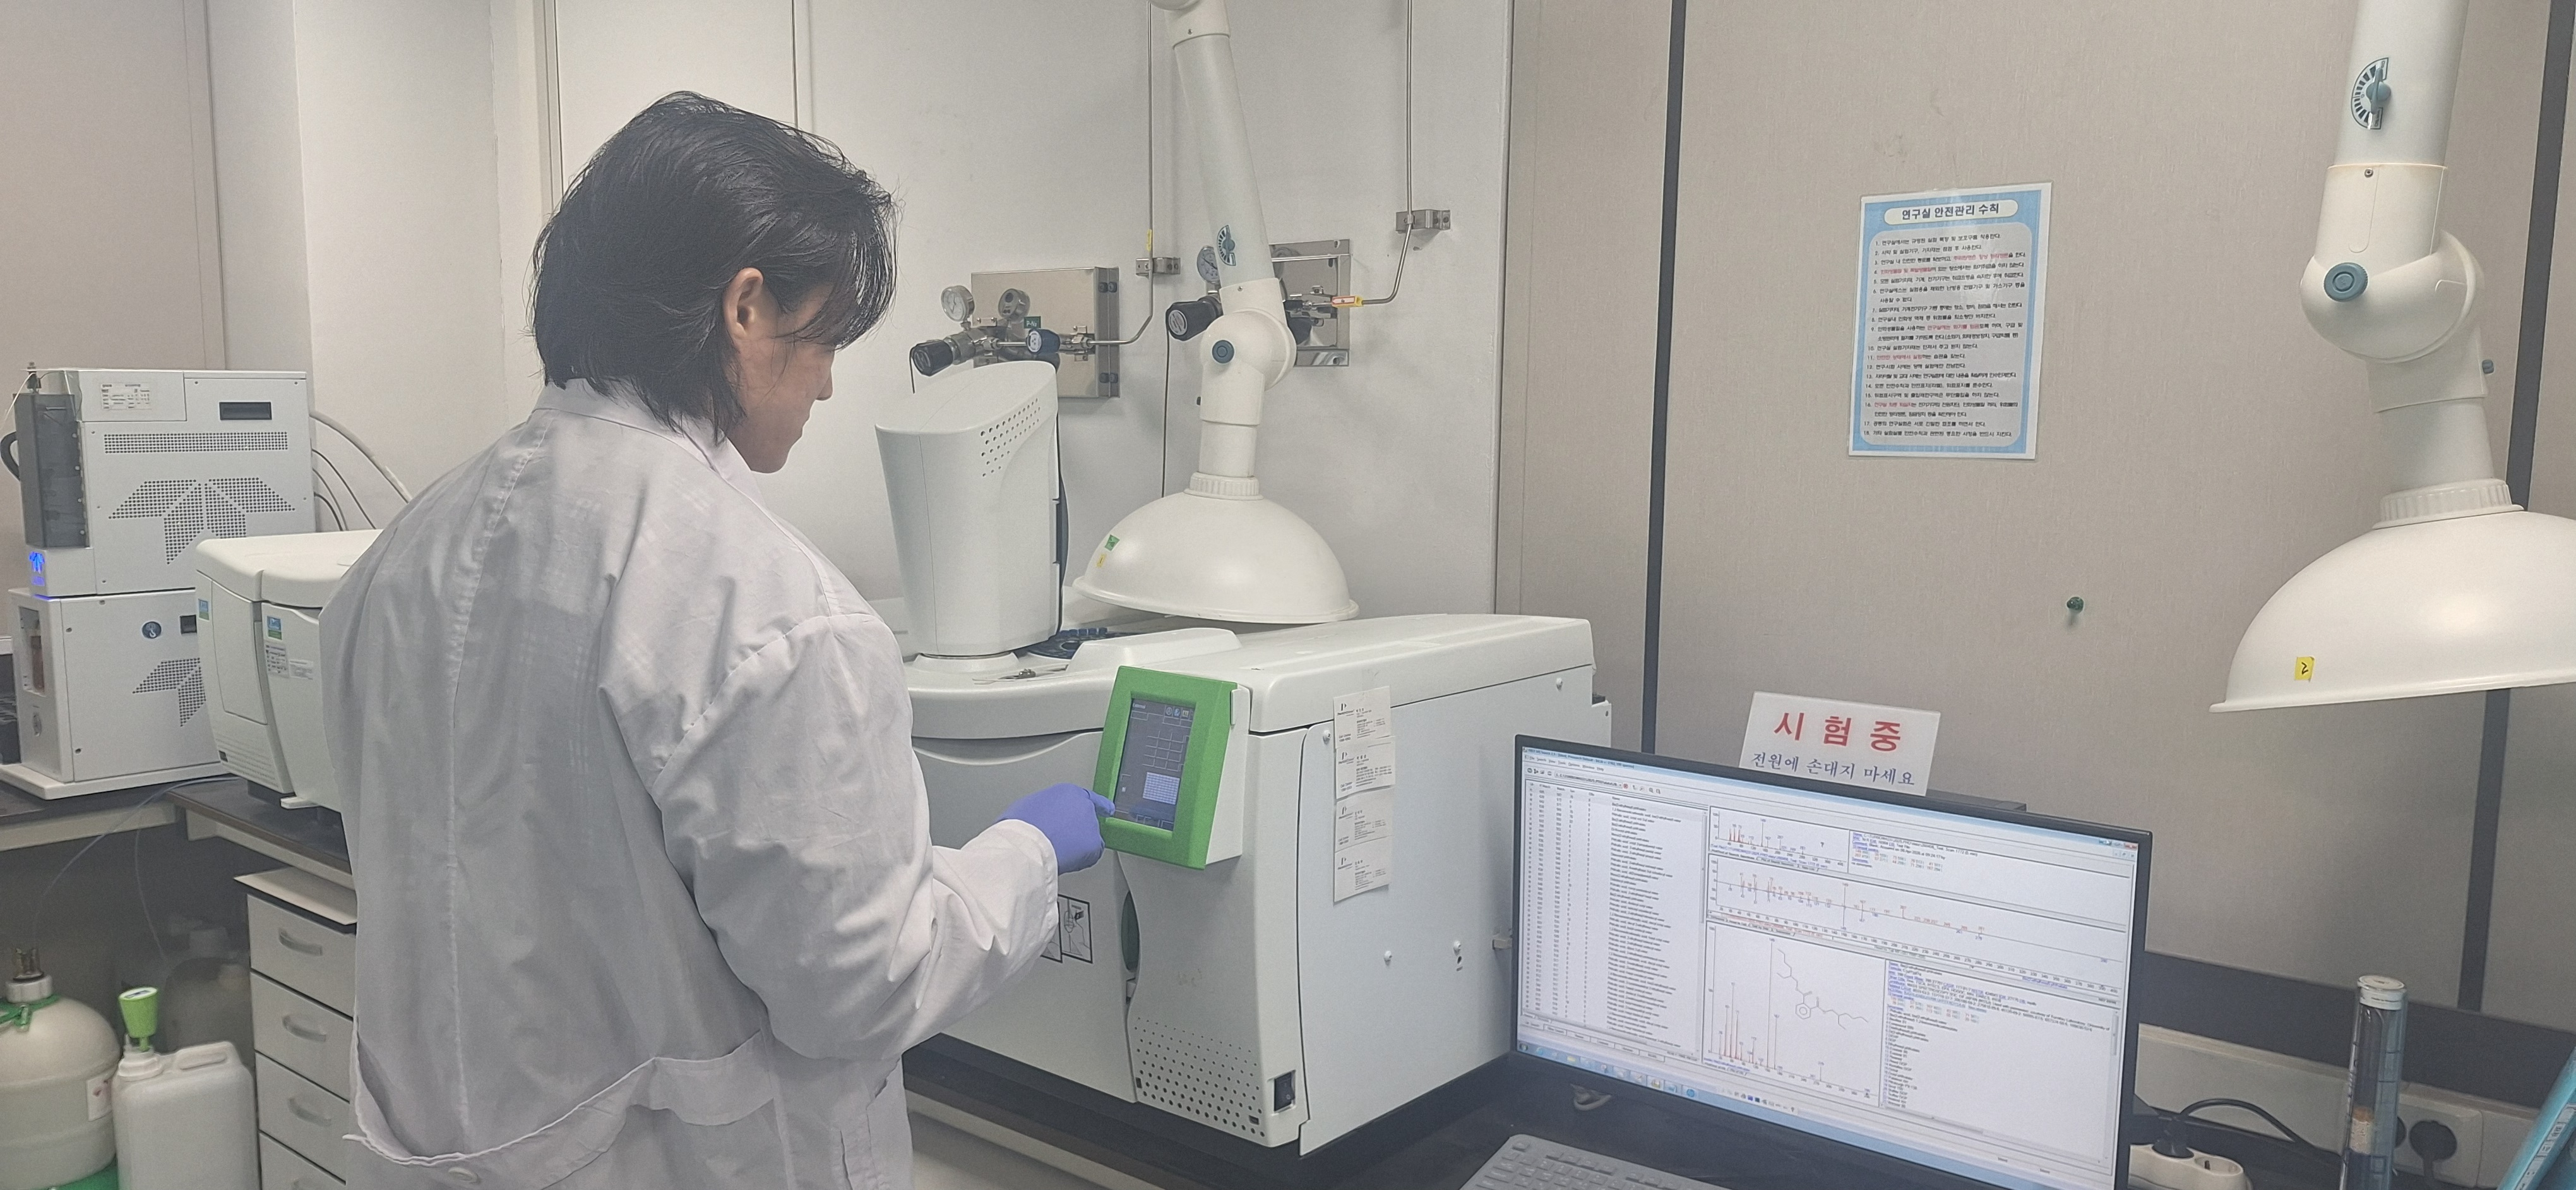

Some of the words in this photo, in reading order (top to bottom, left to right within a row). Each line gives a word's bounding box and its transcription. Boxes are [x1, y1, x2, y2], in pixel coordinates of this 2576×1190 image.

[1902, 208, 1931, 220] 연구실
[1934, 205, 1975, 218] 안전관리
[1978, 203, 2000, 215] 수칙
[2301, 661, 2309, 675] 2
[1773, 712, 1805, 741] 시
[1823, 716, 1852, 747] 험
[1869, 720, 1901, 752] 중
[1751, 752, 1799, 772] 전원에
[1806, 758, 1855, 780] 손대지
[1863, 766, 1916, 786] 마세요
